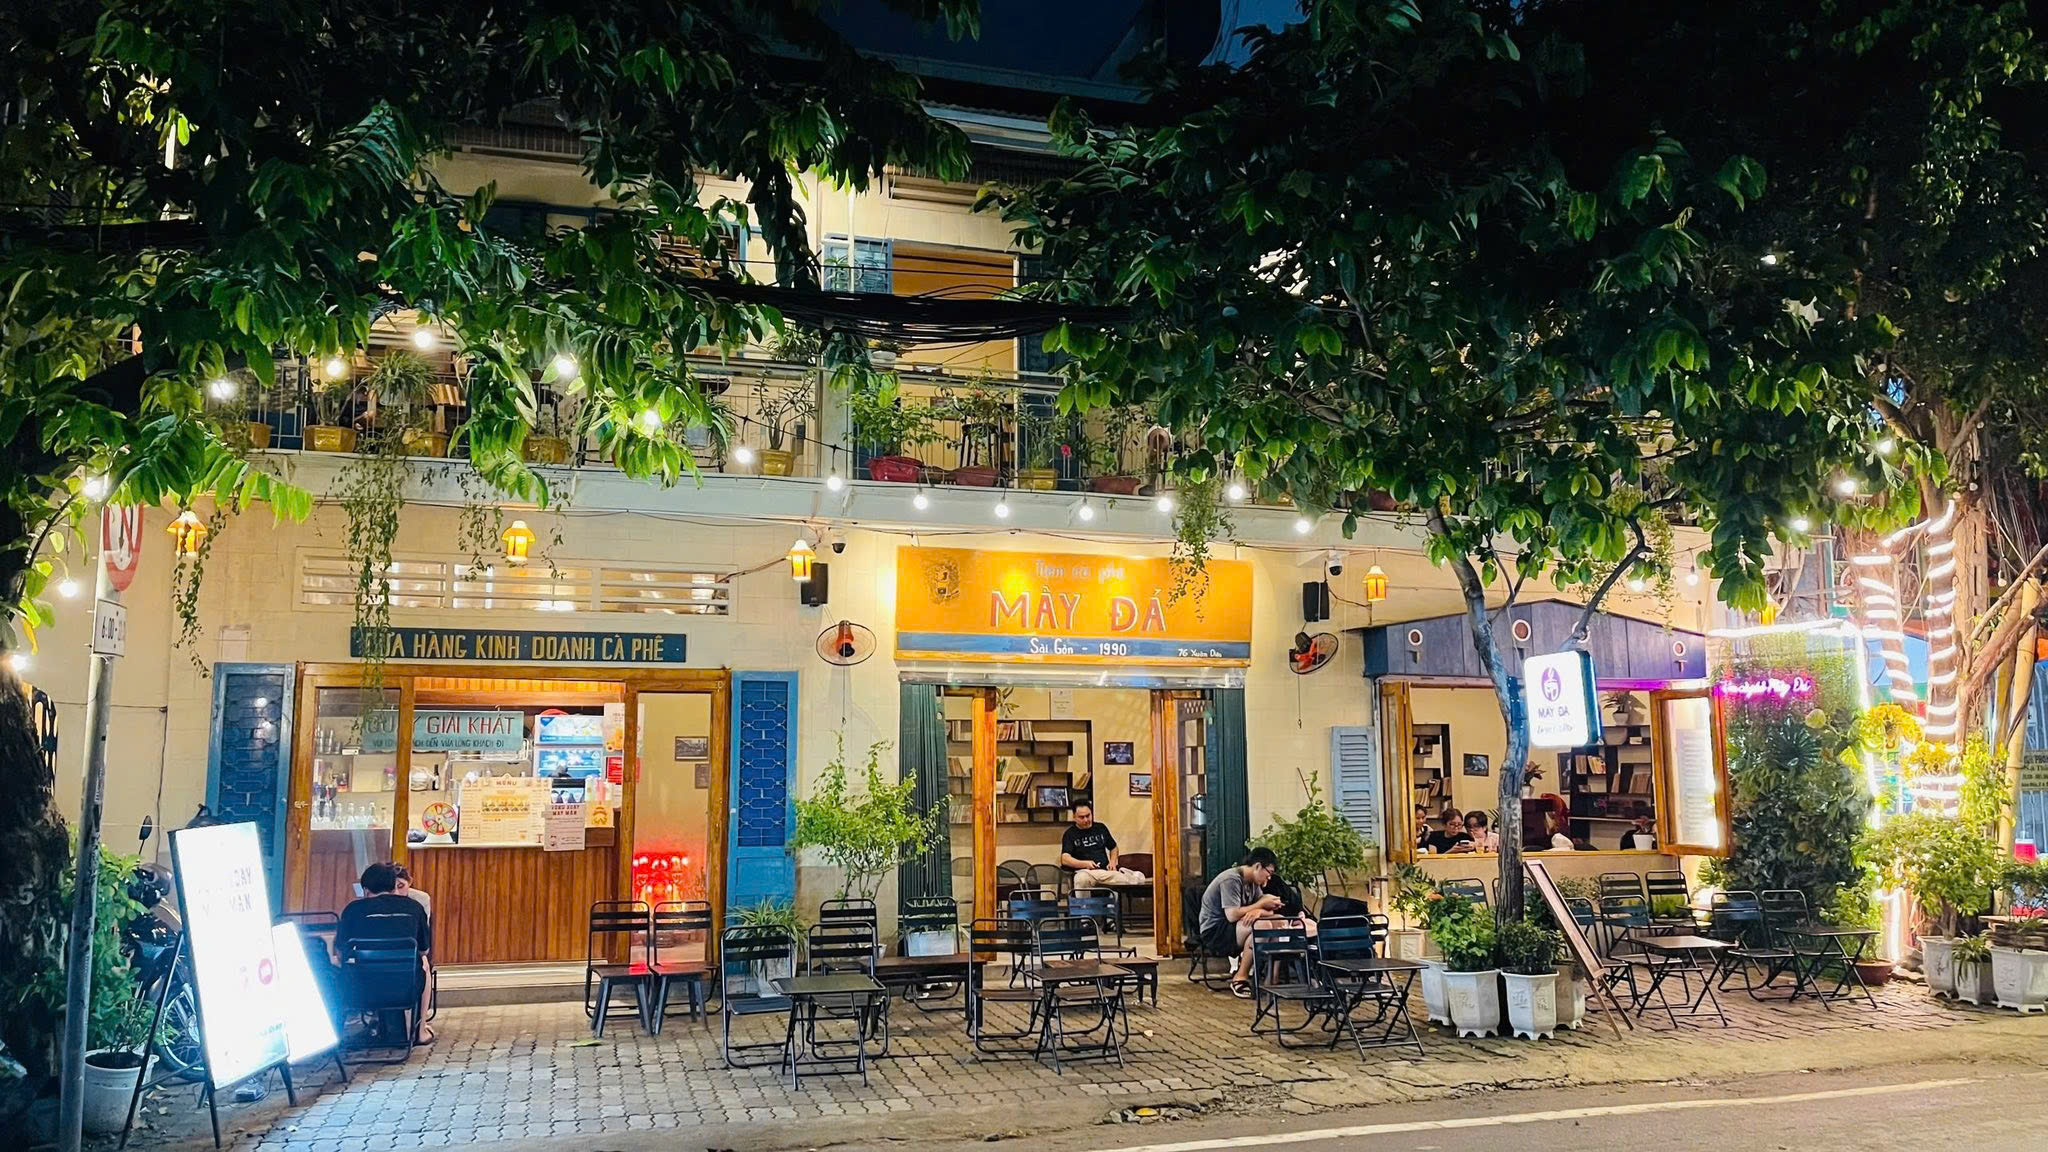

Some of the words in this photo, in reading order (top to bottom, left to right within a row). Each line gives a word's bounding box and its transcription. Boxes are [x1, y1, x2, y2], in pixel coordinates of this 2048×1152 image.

[990, 586, 1081, 630] MÀY
[1110, 589, 1167, 633] ĐÁ
[413, 630, 467, 658] HÀNG
[474, 634, 521, 659] KINH
[531, 635, 595, 660] DOANH
[602, 633, 625, 660] CÀ
[631, 634, 664, 661] PHÊ
[1030, 637, 1049, 654] Sài
[1054, 637, 1074, 654] Gòn
[1099, 643, 1127, 656] 1990
[1177, 648, 1188, 657] 76
[367, 714, 421, 734] QUY
[468, 712, 515, 735] KHÁT
